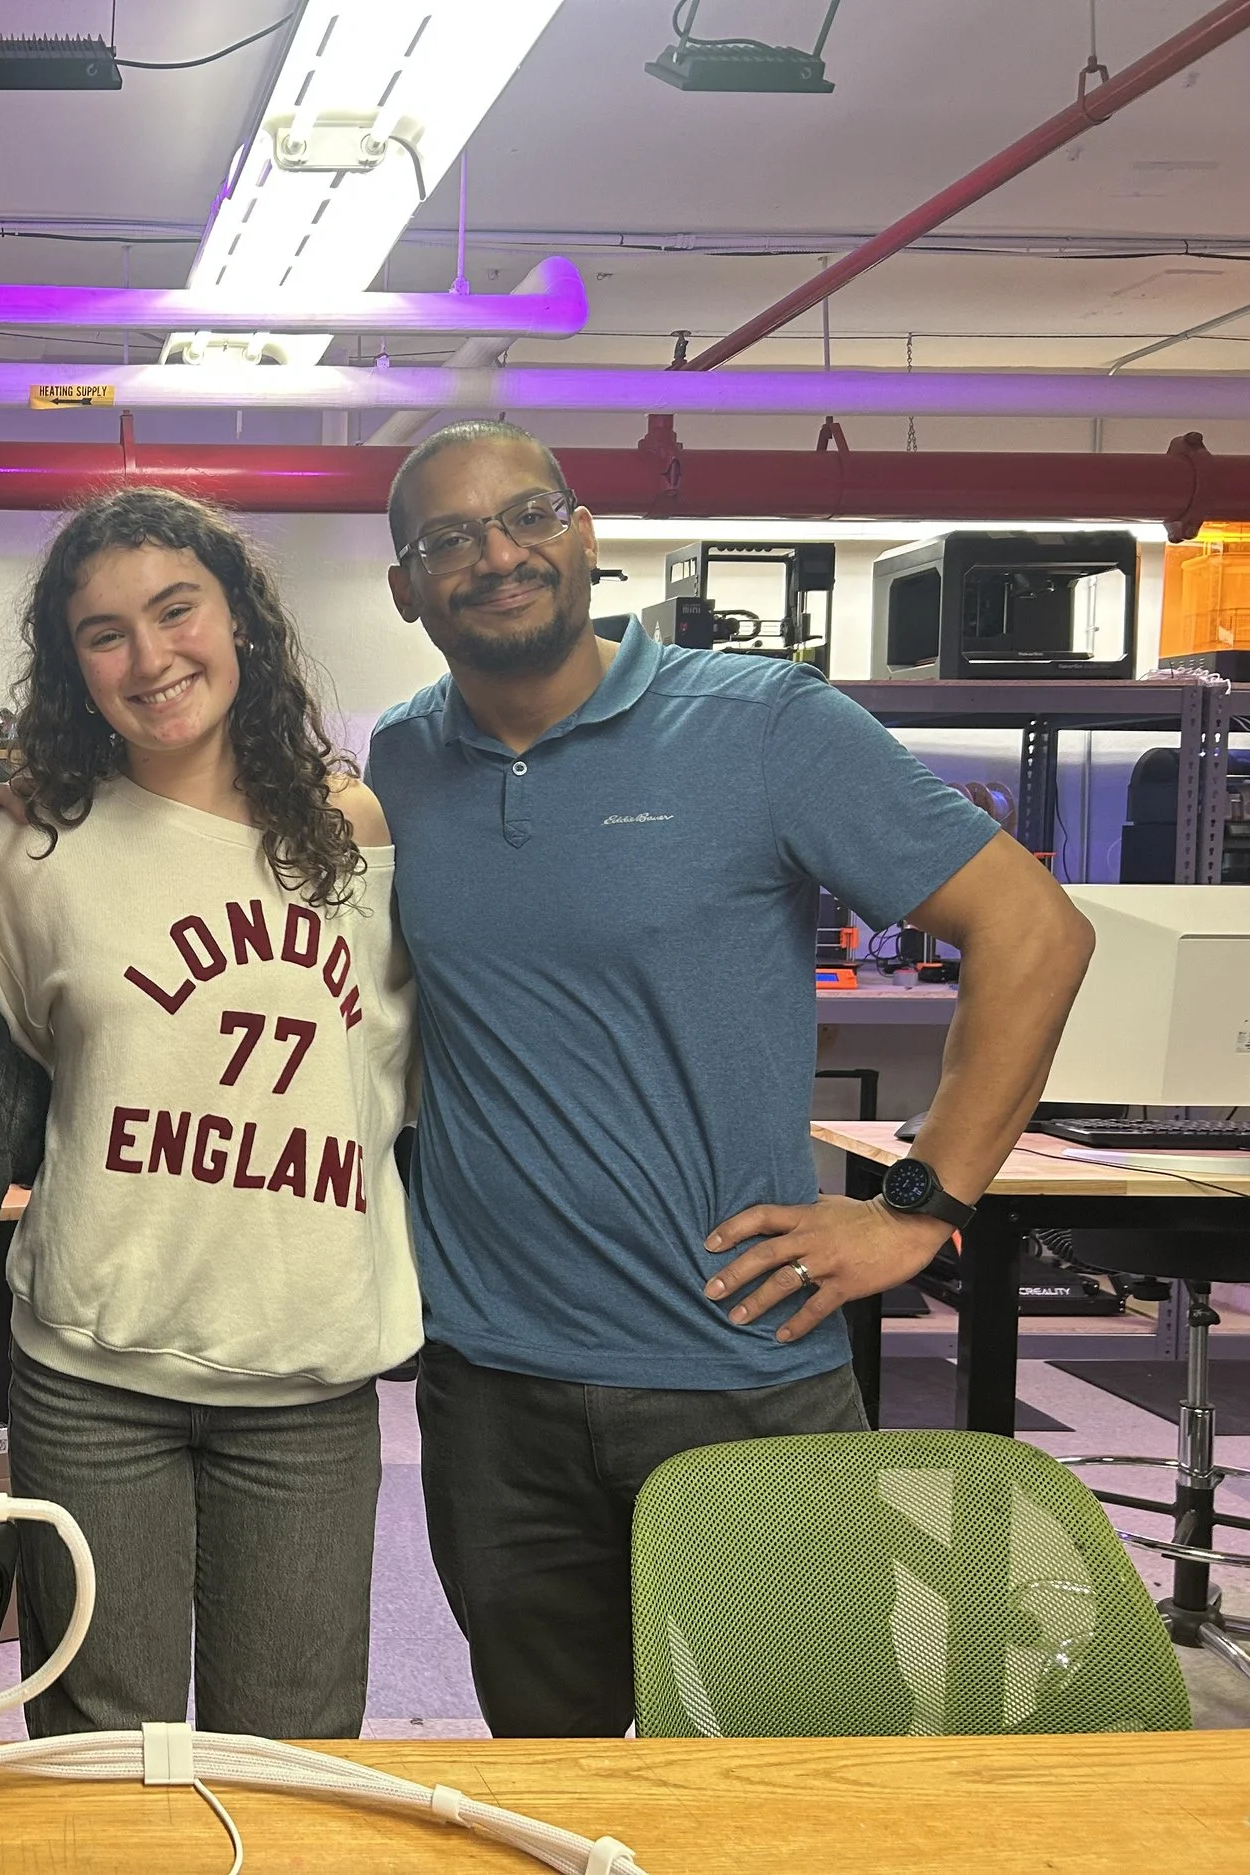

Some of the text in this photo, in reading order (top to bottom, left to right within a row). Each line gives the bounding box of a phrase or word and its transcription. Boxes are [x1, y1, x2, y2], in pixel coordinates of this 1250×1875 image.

[39, 386, 107, 396] HEATING SUPPLY
[123, 899, 363, 1031] LONDON
[219, 1010, 317, 1095] 77
[1018, 1287, 1071, 1296] CREALITY
